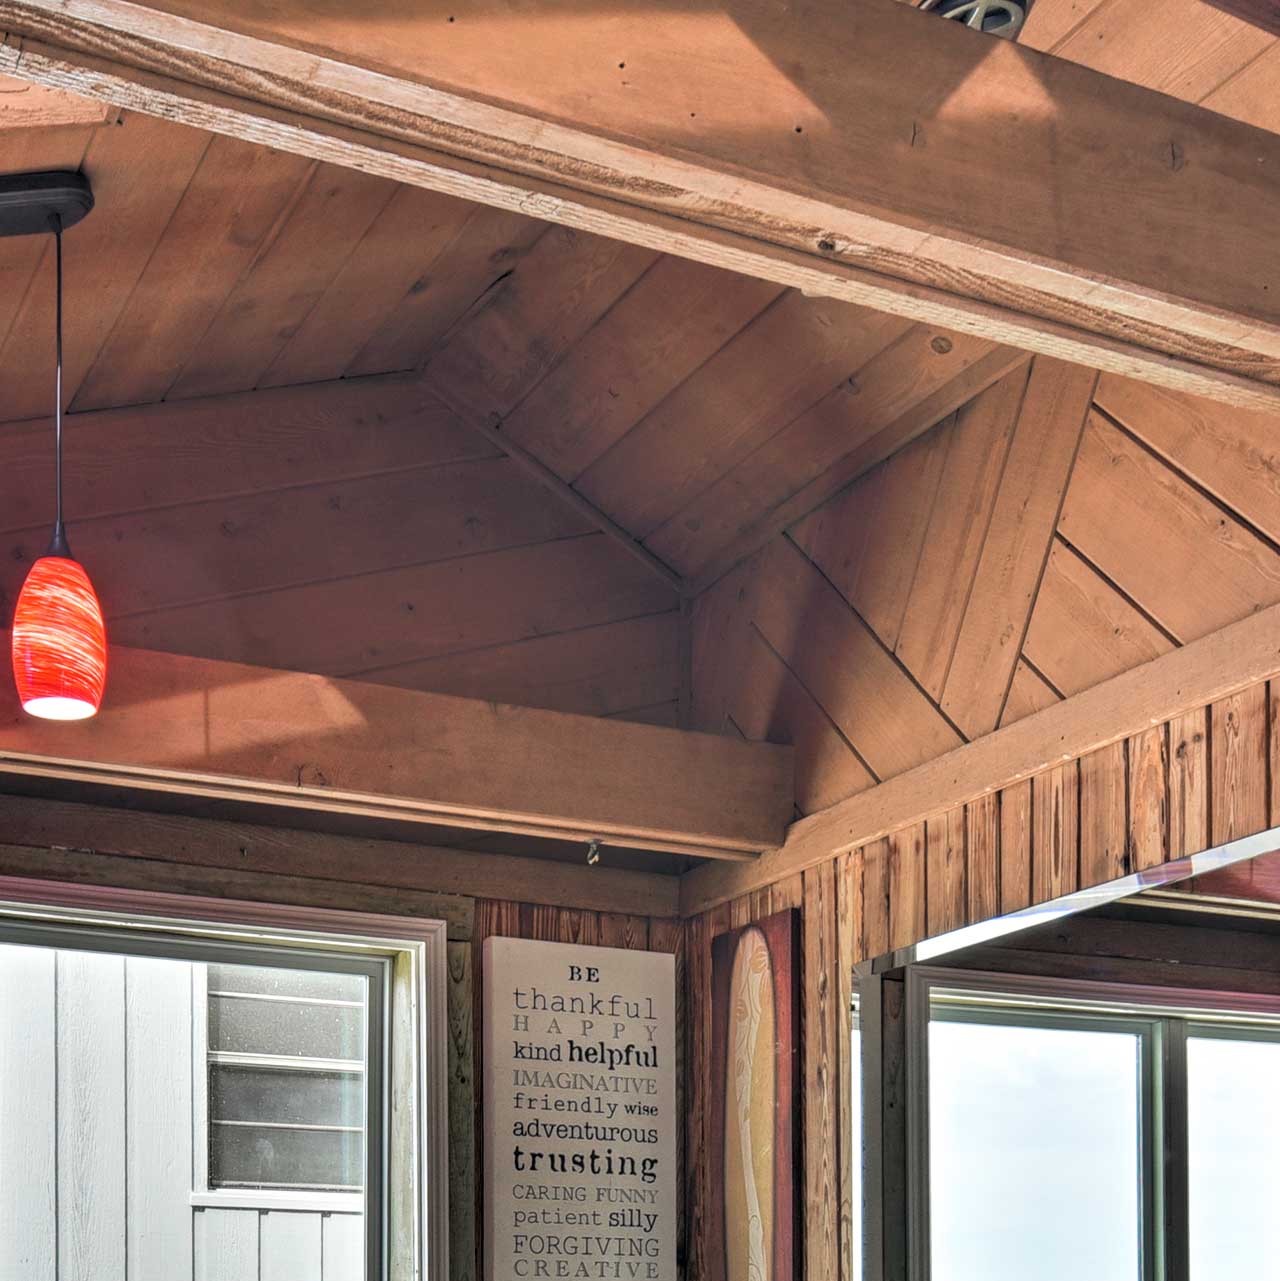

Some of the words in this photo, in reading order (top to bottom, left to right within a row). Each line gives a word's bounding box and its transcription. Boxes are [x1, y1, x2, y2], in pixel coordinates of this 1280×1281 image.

[568, 965, 600, 983] BE
[512, 986, 658, 1020] thankful
[512, 1040, 563, 1062] kind
[567, 1039, 658, 1071] helpful
[512, 1069, 658, 1095] IMAGINATIVE
[513, 1092, 618, 1119] friendly
[624, 1101, 659, 1117] wise
[512, 1118, 659, 1144] adventurous
[513, 1145, 659, 1184] trusting
[512, 1184, 587, 1202] CARING
[595, 1187, 659, 1204] FUNNY
[513, 1208, 603, 1227] patient
[608, 1208, 659, 1233] silly
[513, 1235, 660, 1257] FORGIVING
[513, 1259, 660, 1279] CREATIVE
